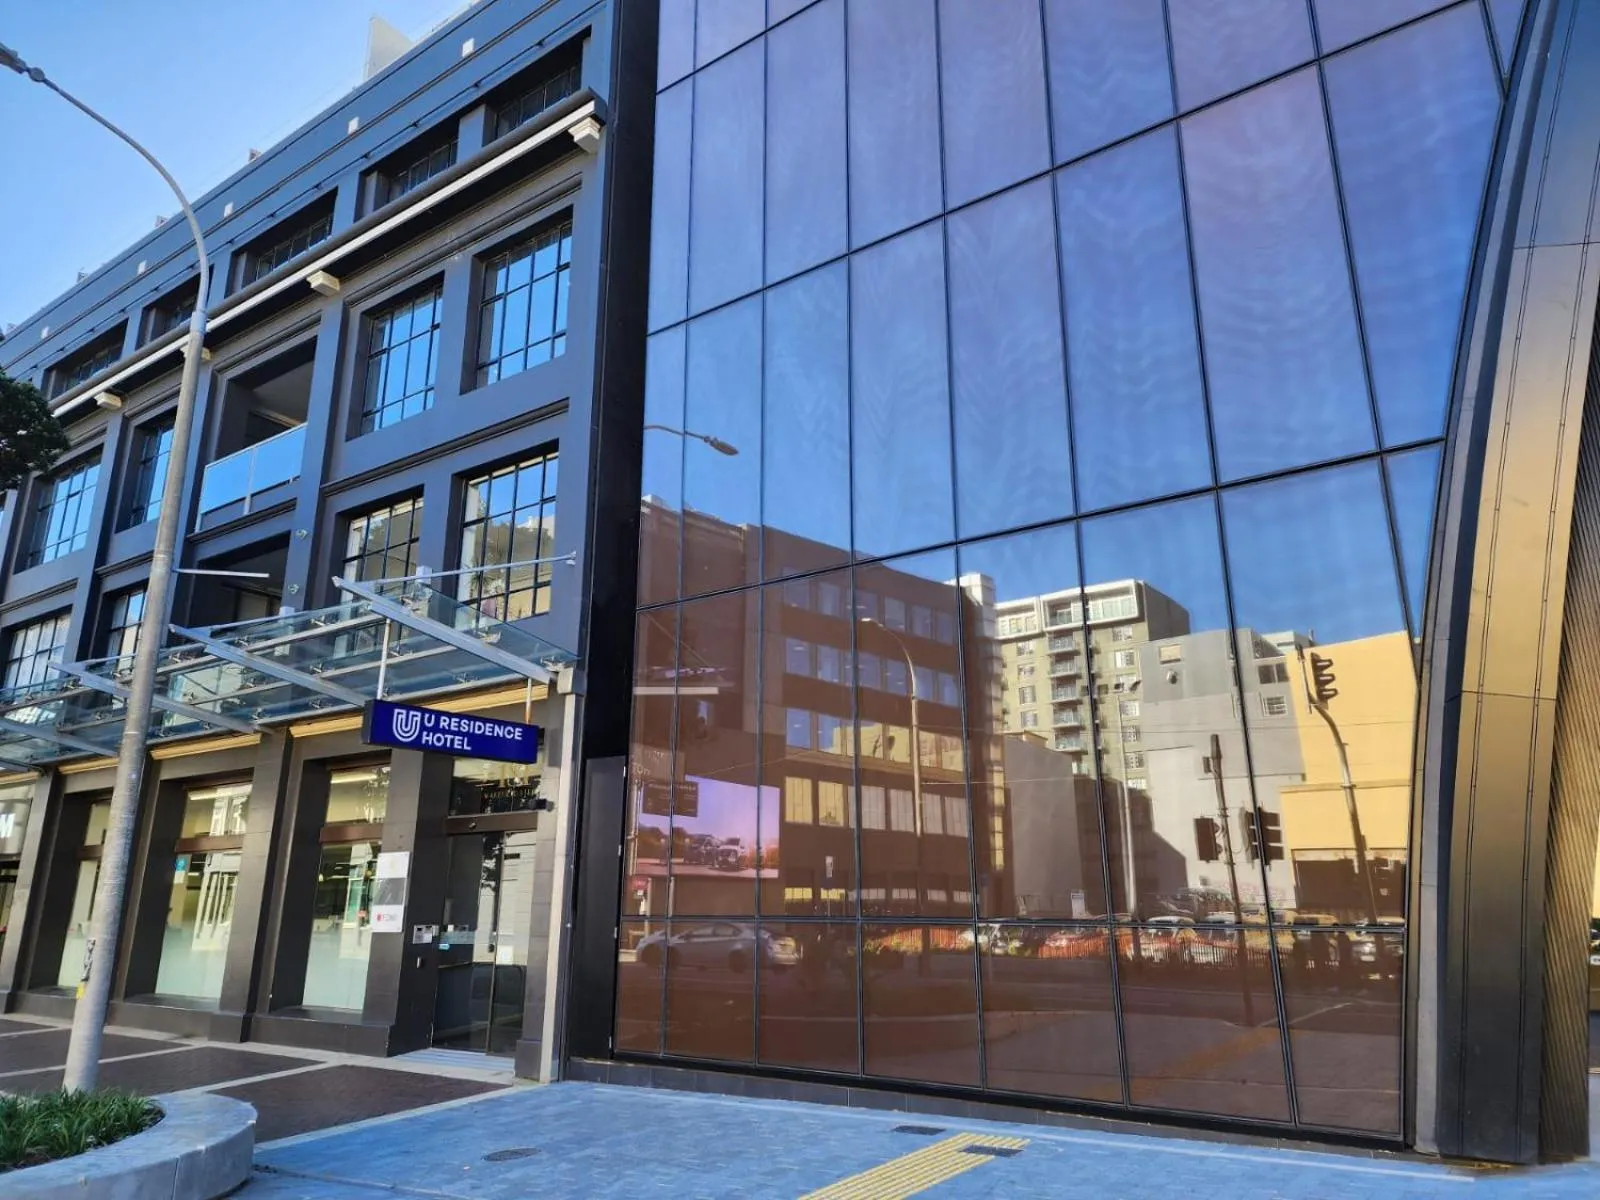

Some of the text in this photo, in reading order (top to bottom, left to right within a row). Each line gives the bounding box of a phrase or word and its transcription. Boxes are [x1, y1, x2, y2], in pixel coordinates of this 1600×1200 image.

[424, 713, 524, 741] U RESIDENCE
[421, 731, 473, 751] HOTEL
